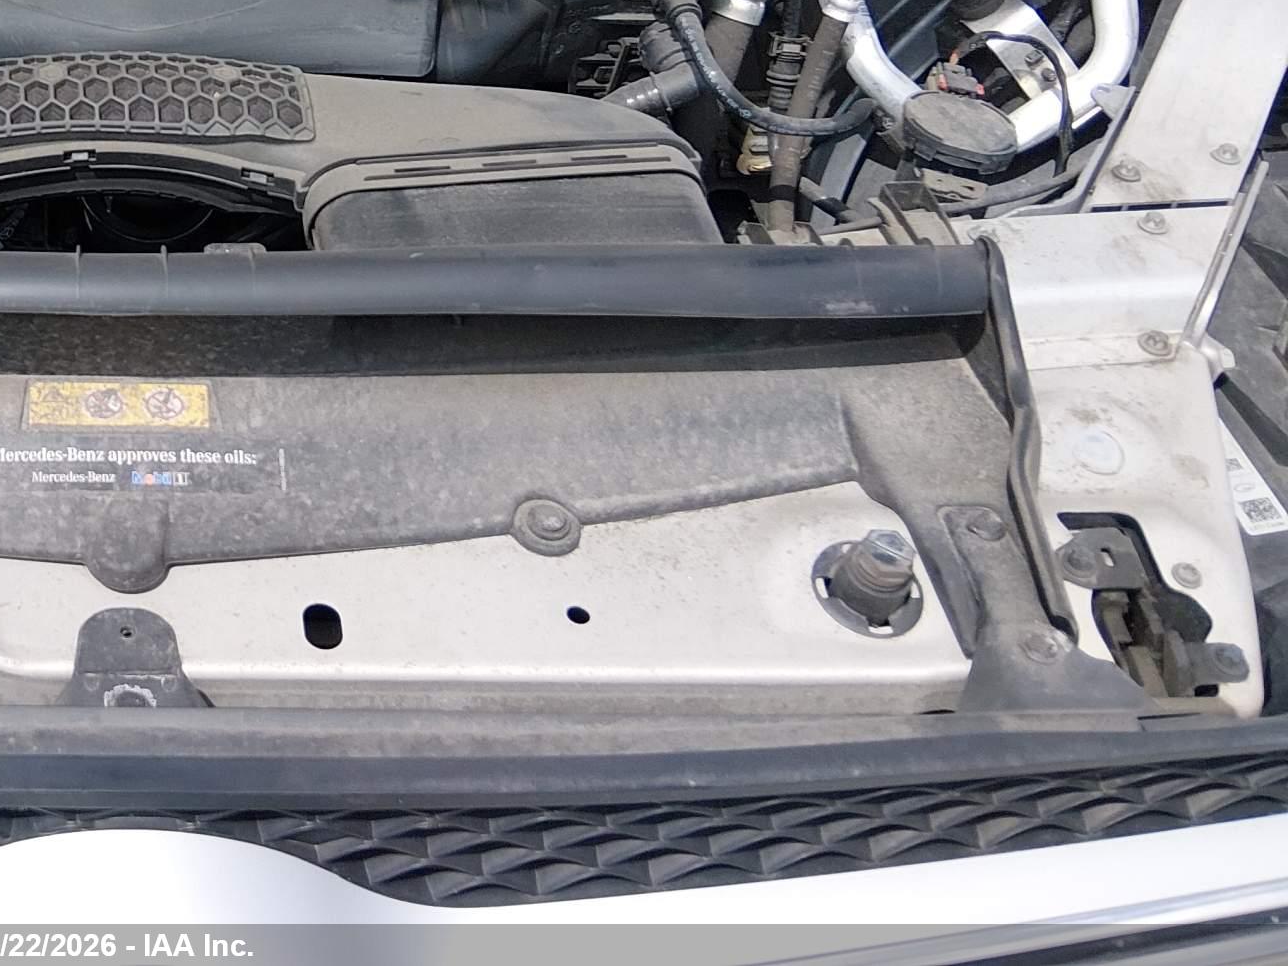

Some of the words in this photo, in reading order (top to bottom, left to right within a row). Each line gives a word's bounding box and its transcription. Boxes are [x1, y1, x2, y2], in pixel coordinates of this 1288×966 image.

[108, 449, 177, 465] approves
[180, 447, 220, 464] these
[224, 448, 257, 465] oils:
[32, 470, 116, 484] Mercedes-Benz
